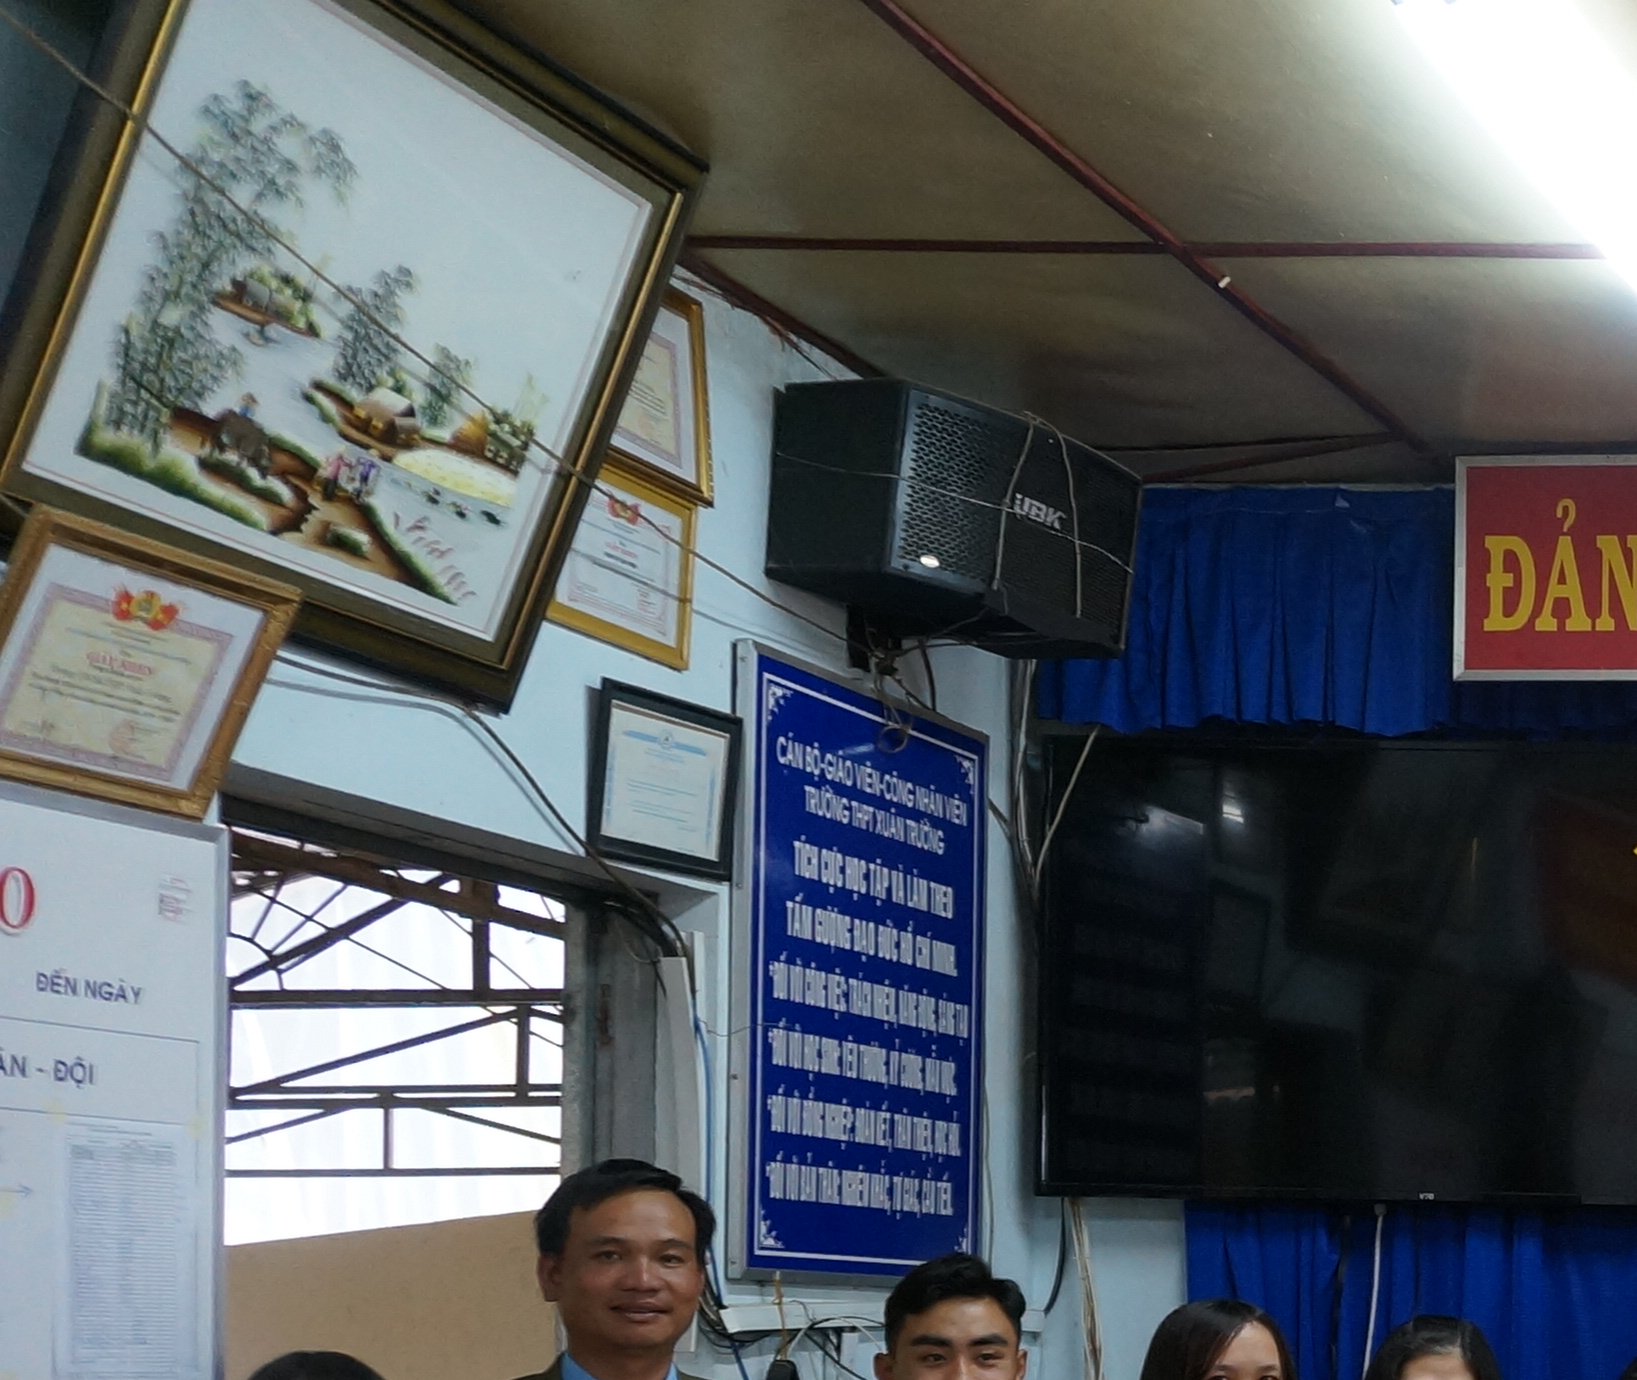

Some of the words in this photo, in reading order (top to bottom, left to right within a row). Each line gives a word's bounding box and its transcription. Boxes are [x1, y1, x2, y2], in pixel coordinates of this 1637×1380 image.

[776, 732, 803, 770] CÁN
[915, 785, 944, 818] NHÂN
[944, 794, 968, 827] VIÊN
[804, 785, 850, 825] TRƯỜNG
[850, 801, 875, 832] THPT
[875, 808, 905, 842] XUÂN
[906, 818, 945, 855] TRƯỜNG
[36, 968, 78, 997] ĐẾN
[84, 978, 143, 1004] NGÀY
[53, 1055, 95, 1089] ĐỘI
